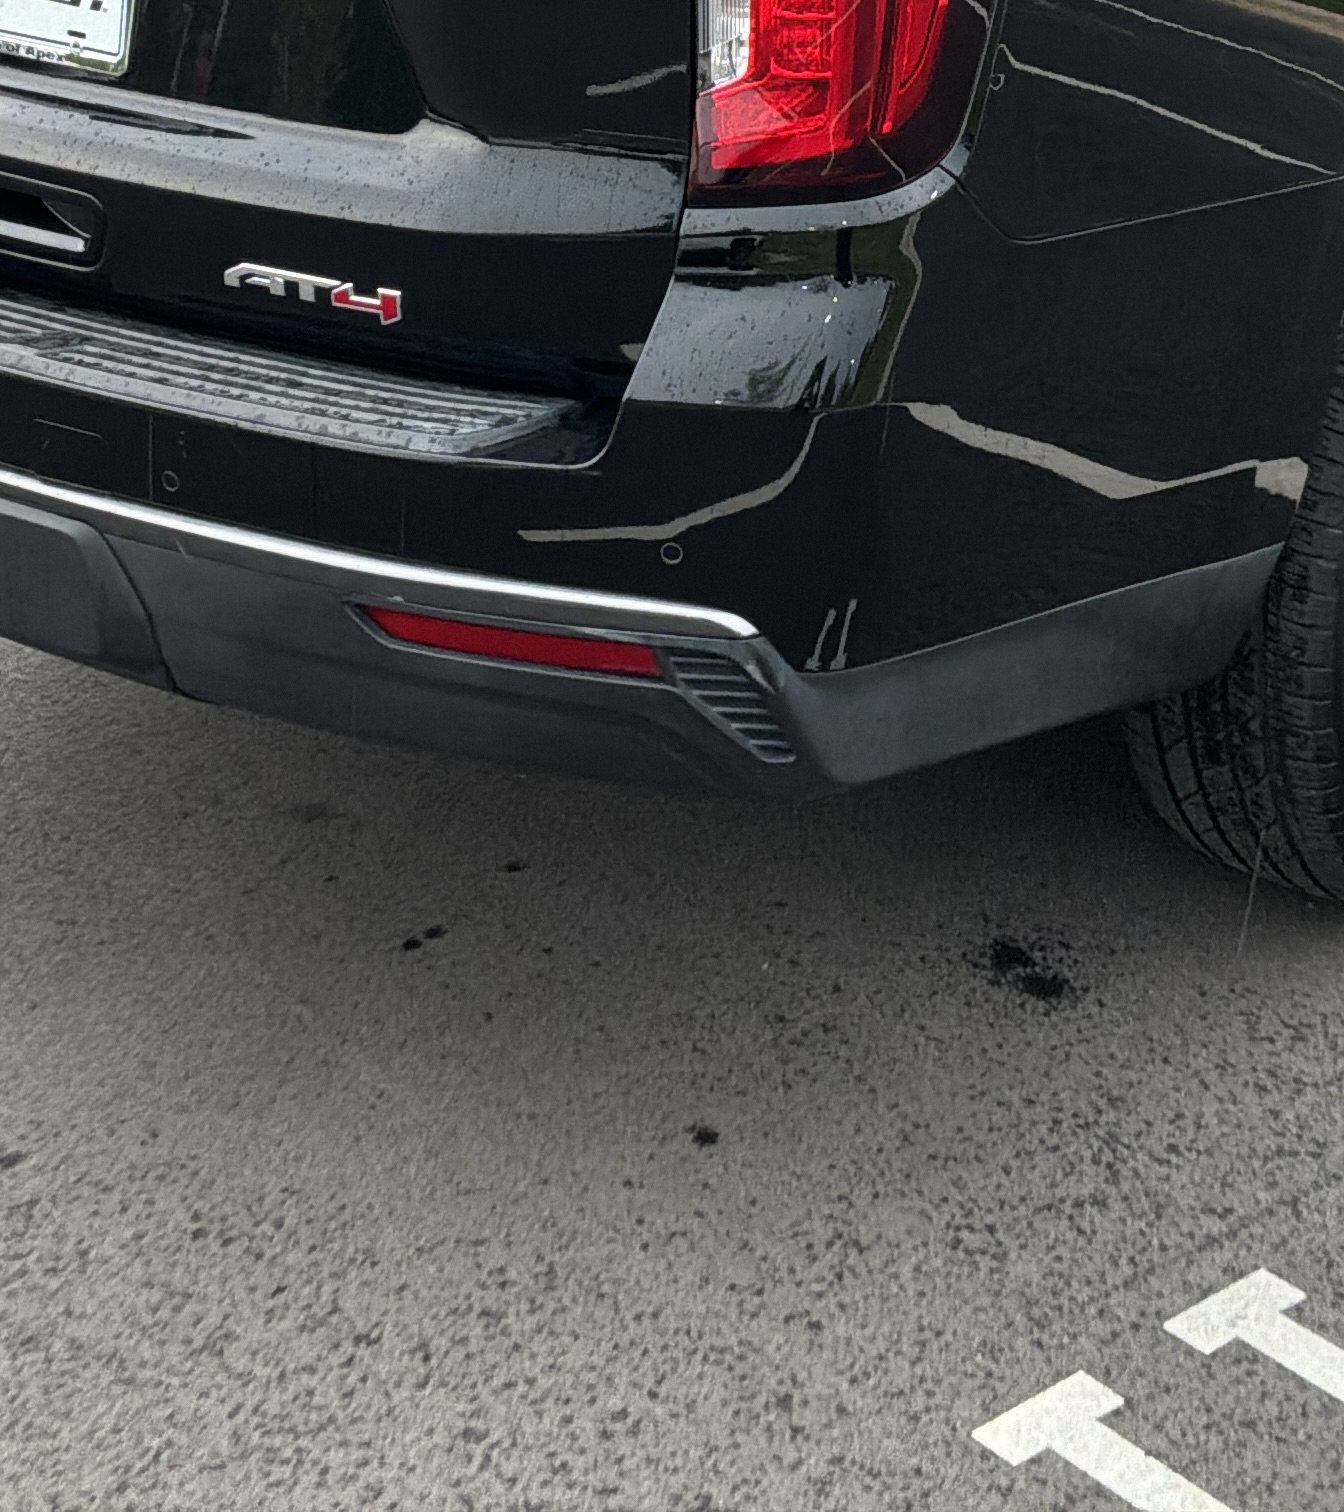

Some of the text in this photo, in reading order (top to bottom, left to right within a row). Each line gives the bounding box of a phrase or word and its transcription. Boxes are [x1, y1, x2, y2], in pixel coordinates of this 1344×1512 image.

[6, 41, 20, 54] of
[25, 45, 66, 63] Apex
[223, 262, 403, 326] AT4
